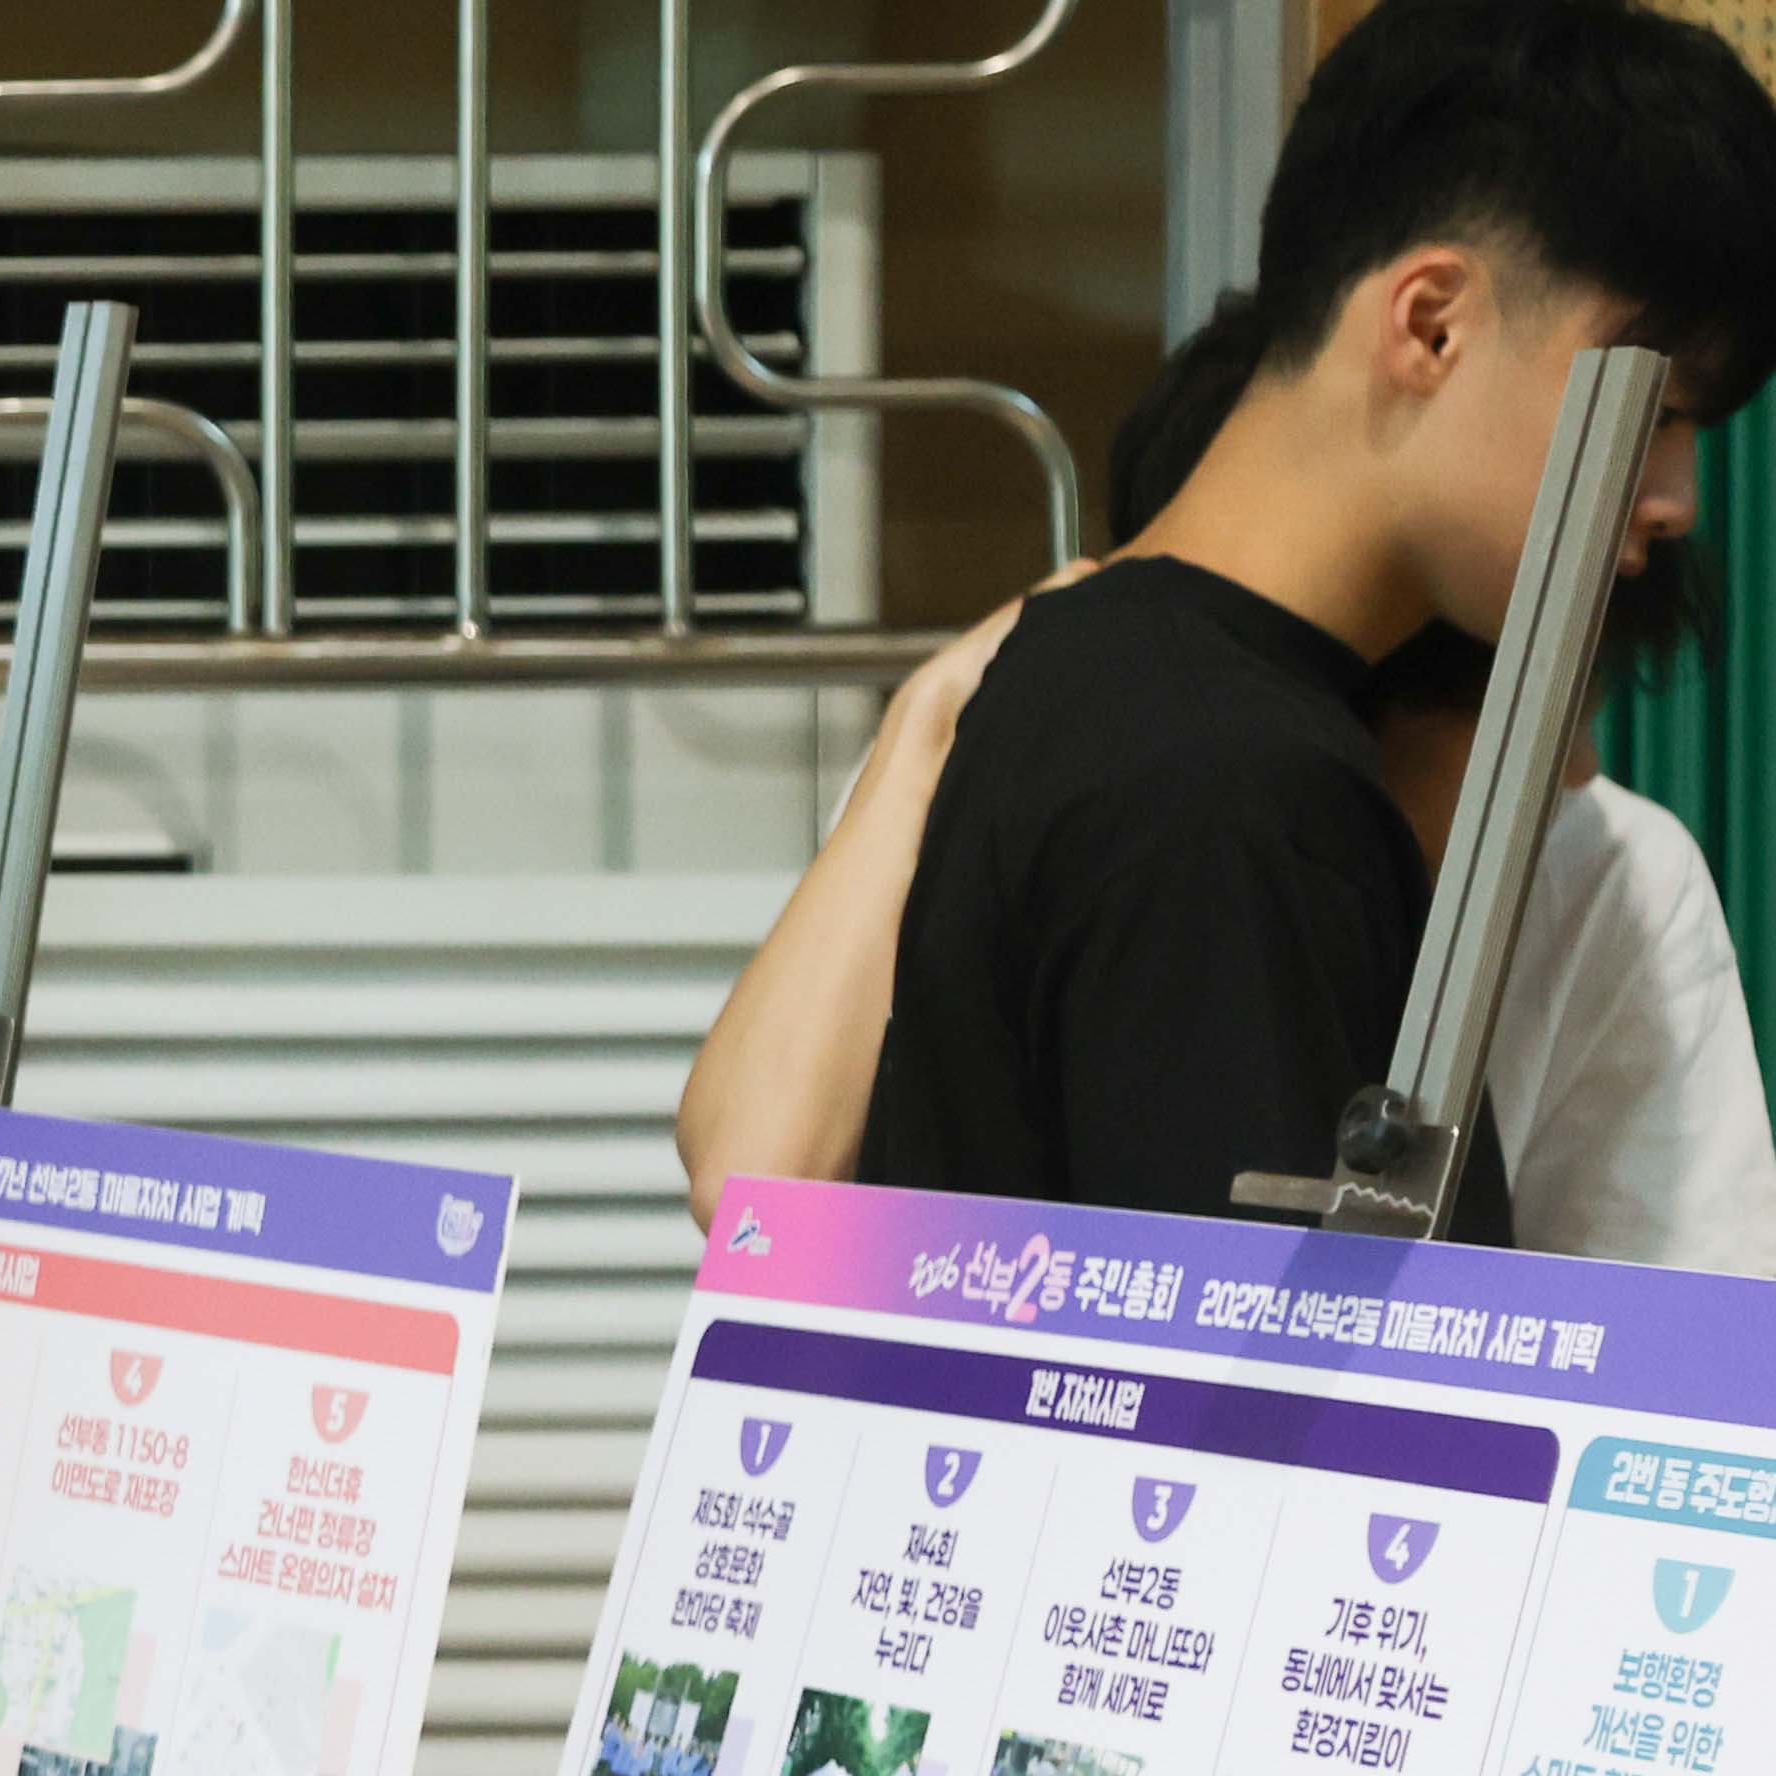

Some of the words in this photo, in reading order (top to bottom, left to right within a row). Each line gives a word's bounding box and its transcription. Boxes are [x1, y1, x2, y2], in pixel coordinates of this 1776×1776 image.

[27, 1160, 100, 1212] 선부2동
[98, 1171, 180, 1223] 마을자치
[177, 1181, 222, 1230] 사업
[224, 1185, 266, 1236] 계획
[909, 1242, 960, 1298] 2026
[962, 1232, 1076, 1324] 선부2동
[1075, 1256, 1183, 1321] 주민총회
[1195, 1279, 1290, 1334] 2027년
[1286, 1289, 1385, 1346] 선부2동
[1380, 1300, 1489, 1359] 마을자치
[1484, 1313, 1546, 1367] 사업
[1545, 1318, 1605, 1375] 계획
[325, 1392, 348, 1433] 5
[1025, 1368, 1054, 1418] 1번
[1052, 1372, 1146, 1431] 자치사업
[56, 1411, 112, 1457] 선부동
[116, 1422, 191, 1470] 1150-8
[754, 1423, 771, 1467] 1
[51, 1458, 123, 1506] 이면도로
[122, 1471, 180, 1519] 재포장
[285, 1454, 364, 1505] 한신더휴
[936, 1451, 961, 1497] 2
[1604, 1450, 1660, 1507] 2번
[1657, 1456, 1694, 1512] 동
[1691, 1463, 1776, 1526] 주도형
[257, 1498, 317, 1547] 건너편
[316, 1508, 377, 1559] 정류장
[692, 1486, 743, 1531] 제5회
[742, 1497, 796, 1541] 석수골
[1146, 1484, 1172, 1531] 3
[694, 1540, 766, 1587] 상호문화
[902, 1523, 959, 1570] 제4회
[1384, 1523, 1411, 1571] 4
[218, 1543, 277, 1587] 스마트
[276, 1551, 356, 1605] 온열의자
[355, 1563, 399, 1614] 설치
[851, 1568, 893, 1619] 자연,
[897, 1576, 920, 1624] 빛,
[923, 1580, 984, 1630] 건강을
[1101, 1557, 1181, 1611] 선부2동
[1680, 1569, 1702, 1618] 1
[670, 1584, 726, 1634] 한마당
[724, 1595, 763, 1640] 축제
[1043, 1602, 1126, 1659] 이웃사촌
[1126, 1615, 1216, 1676] 마니또와
[1325, 1596, 1376, 1646] 기후
[1378, 1605, 1429, 1663] 위기,
[874, 1627, 934, 1675] 누리다
[1613, 1647, 1724, 1709] 보행환경
[1056, 1662, 1103, 1712] 함께
[1102, 1672, 1170, 1723] 세계로
[1280, 1646, 1377, 1707] 동네에서
[1375, 1666, 1450, 1721] 맞서는
[1291, 1708, 1412, 1774] 환경지킴이
[1583, 1703, 1664, 1762] 개선을
[1667, 1718, 1724, 1774] 위한
